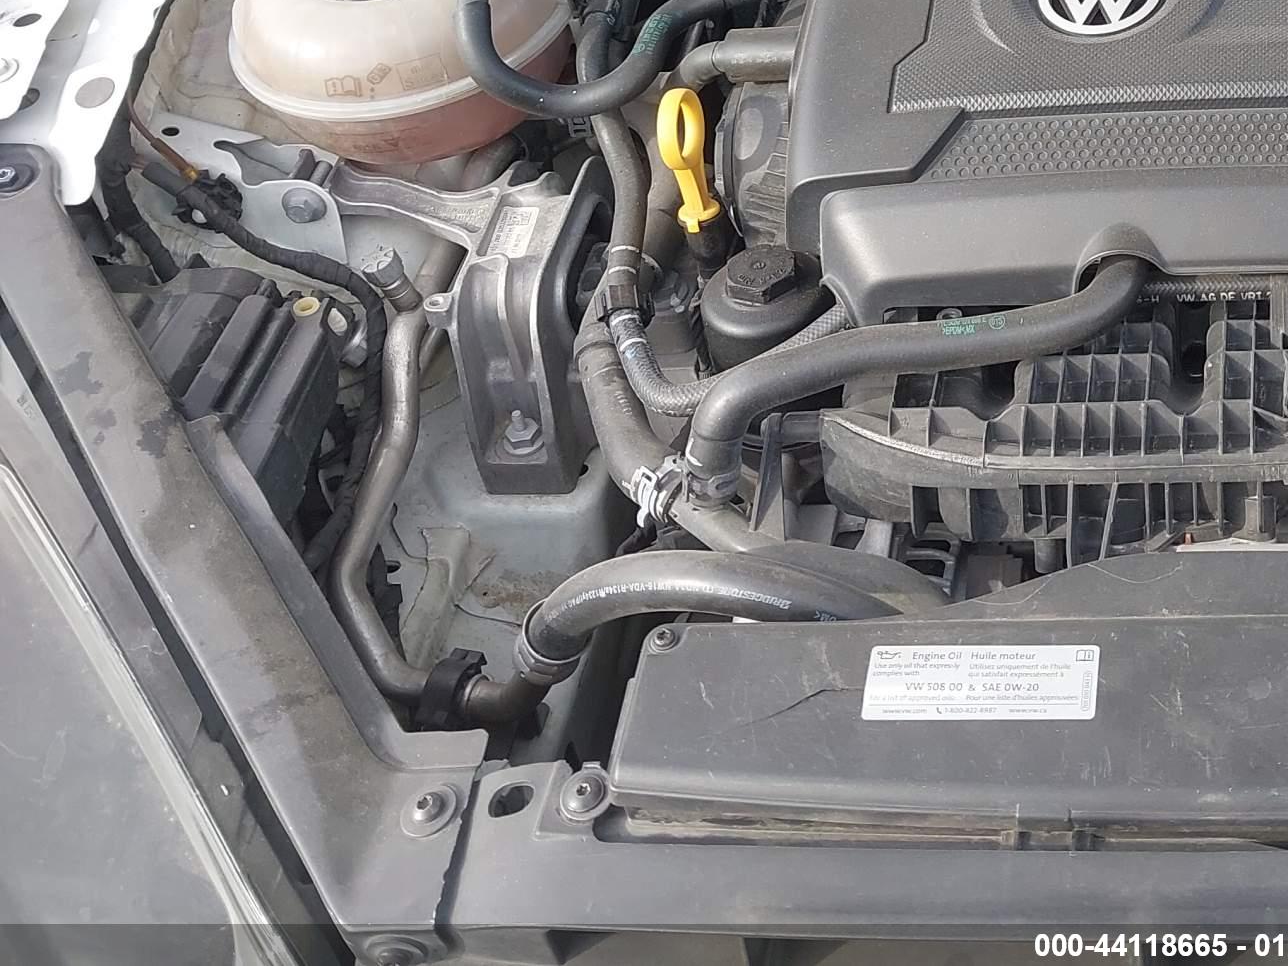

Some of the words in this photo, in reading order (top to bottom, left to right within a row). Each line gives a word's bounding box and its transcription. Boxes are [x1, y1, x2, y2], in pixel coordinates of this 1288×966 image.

[912, 651, 946, 662] Engine
[948, 651, 962, 660] Oil
[971, 651, 997, 660] Huile
[999, 652, 1036, 660] moteur
[905, 682, 925, 691] VW
[948, 682, 963, 692] 00
[968, 683, 976, 692] &
[982, 682, 1002, 692] SAE
[1004, 682, 1040, 692] 0W-20
